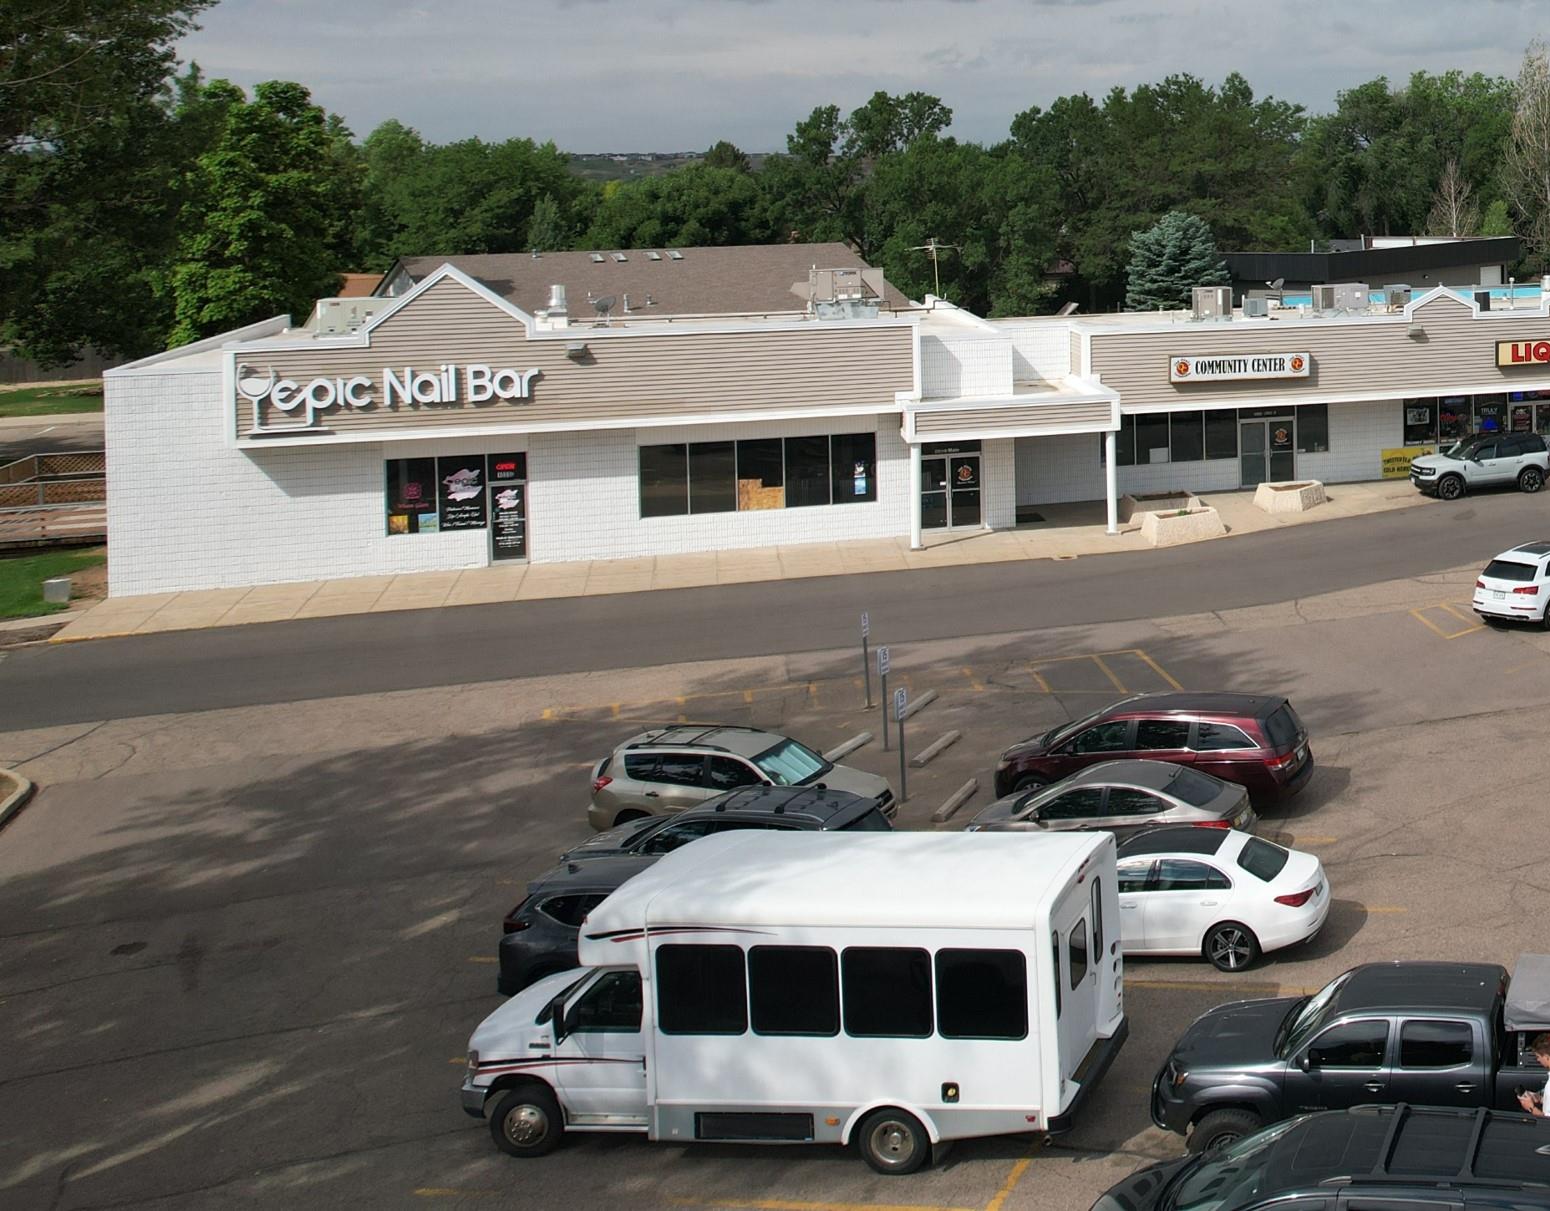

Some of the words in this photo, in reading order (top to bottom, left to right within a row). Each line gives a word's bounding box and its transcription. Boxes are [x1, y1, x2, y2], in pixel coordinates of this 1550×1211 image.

[1195, 358, 1249, 375] COMMUNITY
[1251, 357, 1286, 373] CENTER
[270, 376, 373, 427] epic
[383, 364, 457, 406] Nail
[467, 363, 540, 402] Bar
